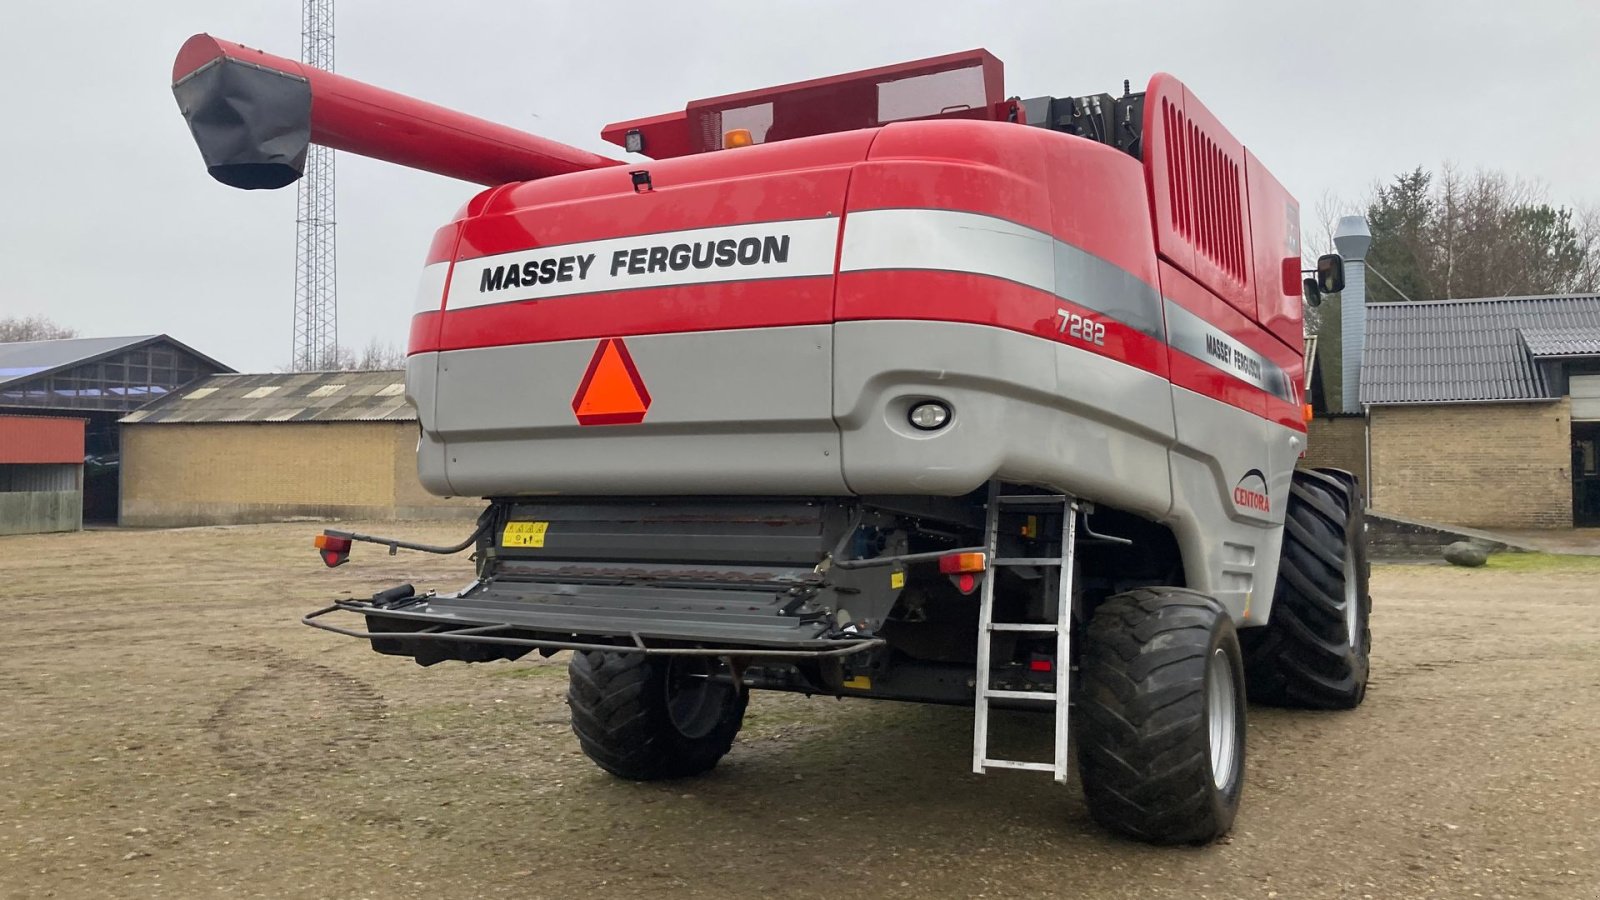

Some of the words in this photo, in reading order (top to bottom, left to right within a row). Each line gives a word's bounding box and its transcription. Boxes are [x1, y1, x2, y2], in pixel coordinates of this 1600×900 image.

[480, 253, 595, 292] MASSEY
[610, 235, 790, 276] FERGUSON
[1057, 308, 1105, 346] 7282
[1206, 333, 1231, 364] MASSEY
[1234, 349, 1261, 380] FERGUSON
[1234, 487, 1270, 513] CENTORA
